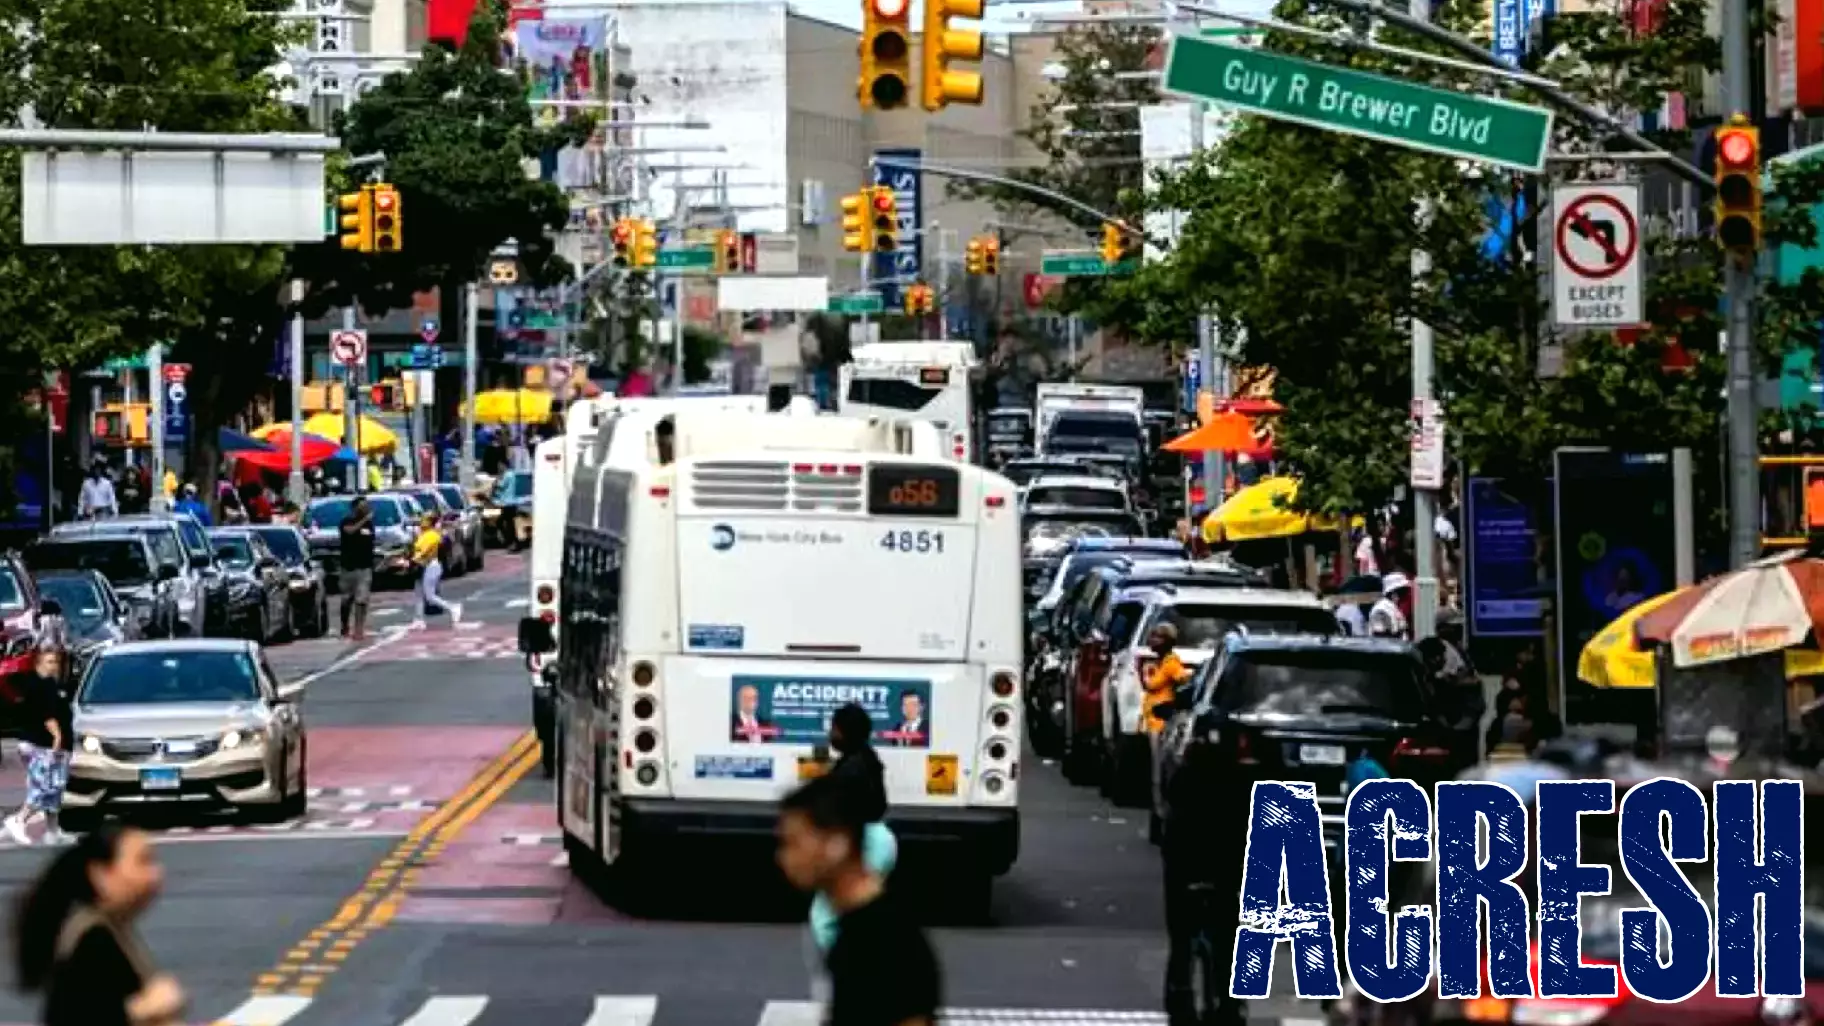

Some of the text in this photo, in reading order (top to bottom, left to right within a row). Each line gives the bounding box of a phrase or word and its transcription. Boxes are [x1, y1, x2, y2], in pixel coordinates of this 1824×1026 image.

[1223, 60, 1492, 145] Guy R Brewer Blvd
[1568, 285, 1626, 301] EXCEPT
[1572, 303, 1624, 318] BUSES
[880, 529, 945, 553] 4851
[773, 682, 889, 702] ACCIDENT?
